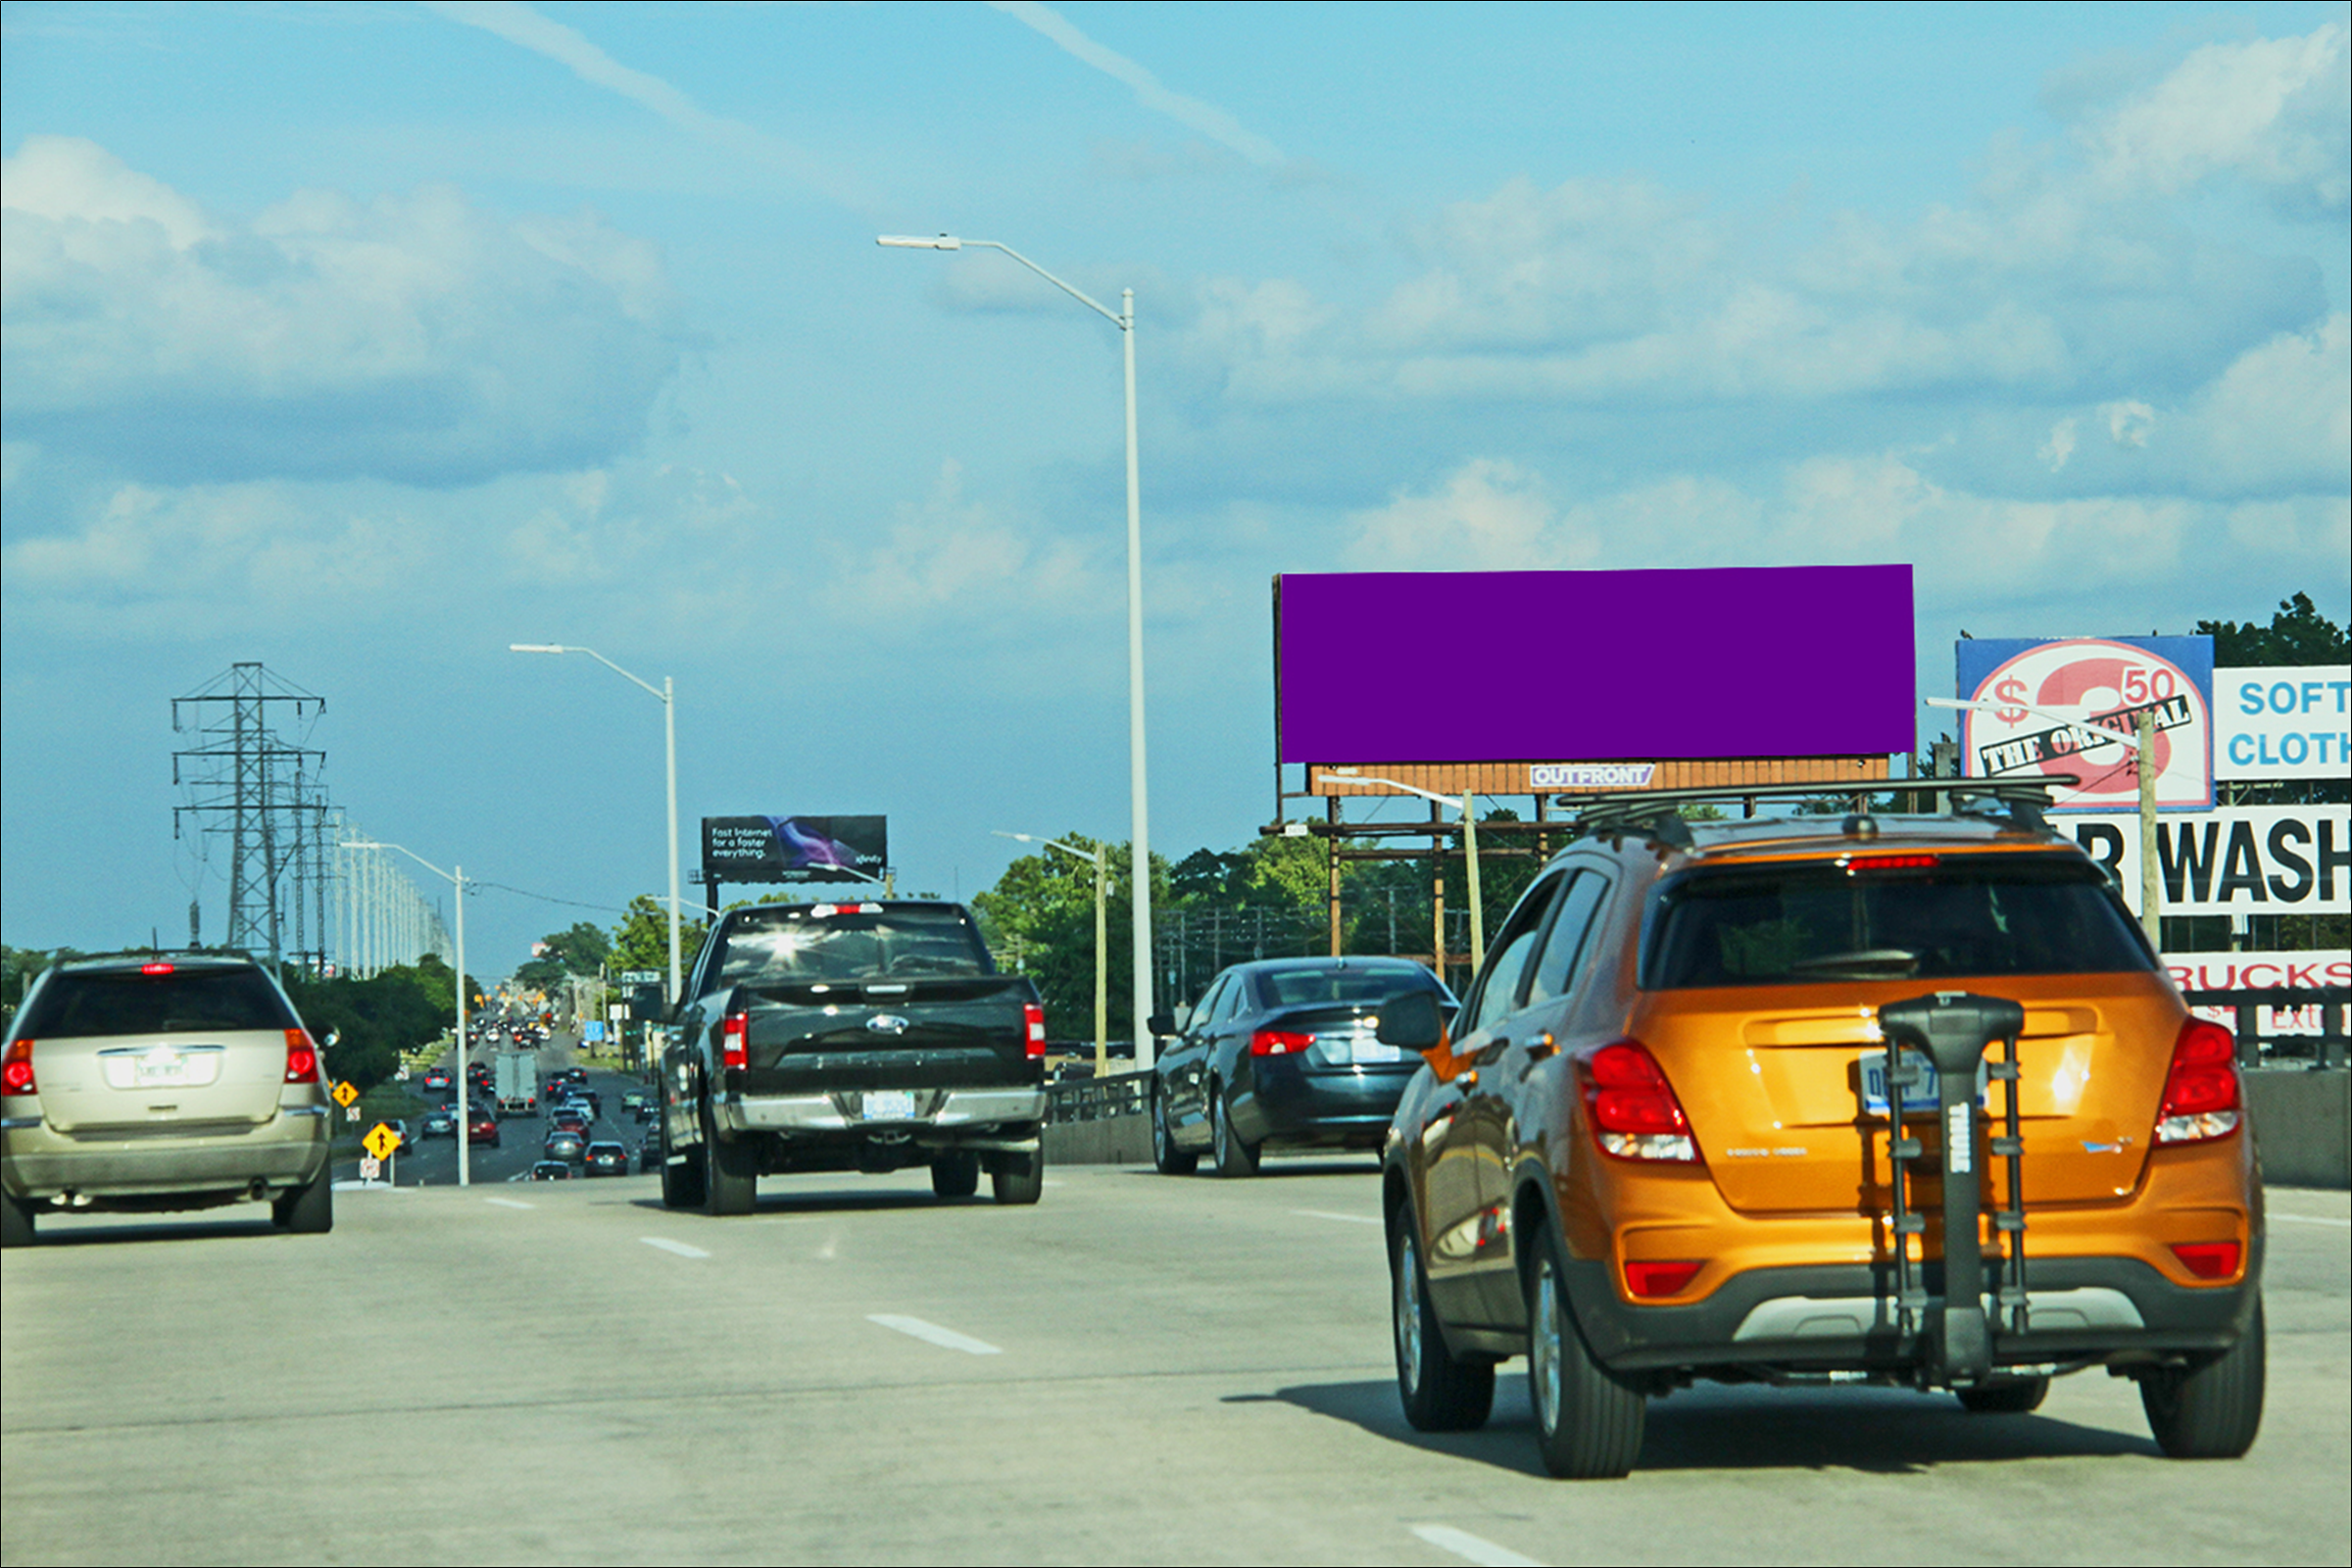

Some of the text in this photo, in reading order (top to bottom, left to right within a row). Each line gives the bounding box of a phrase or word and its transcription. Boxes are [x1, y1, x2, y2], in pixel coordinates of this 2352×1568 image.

[2239, 681, 2351, 715] SOFT
[1983, 737, 2044, 773] THE
[1534, 766, 1647, 784] OUTFRONT
[712, 827, 772, 837] Fast Internet
[712, 838, 726, 848] for
[737, 836, 765, 848] faster
[712, 849, 766, 859] everything.
[856, 854, 882, 864] xfinity
[2156, 818, 2351, 904] WASH
[1948, 1102, 1971, 1173] THULE
